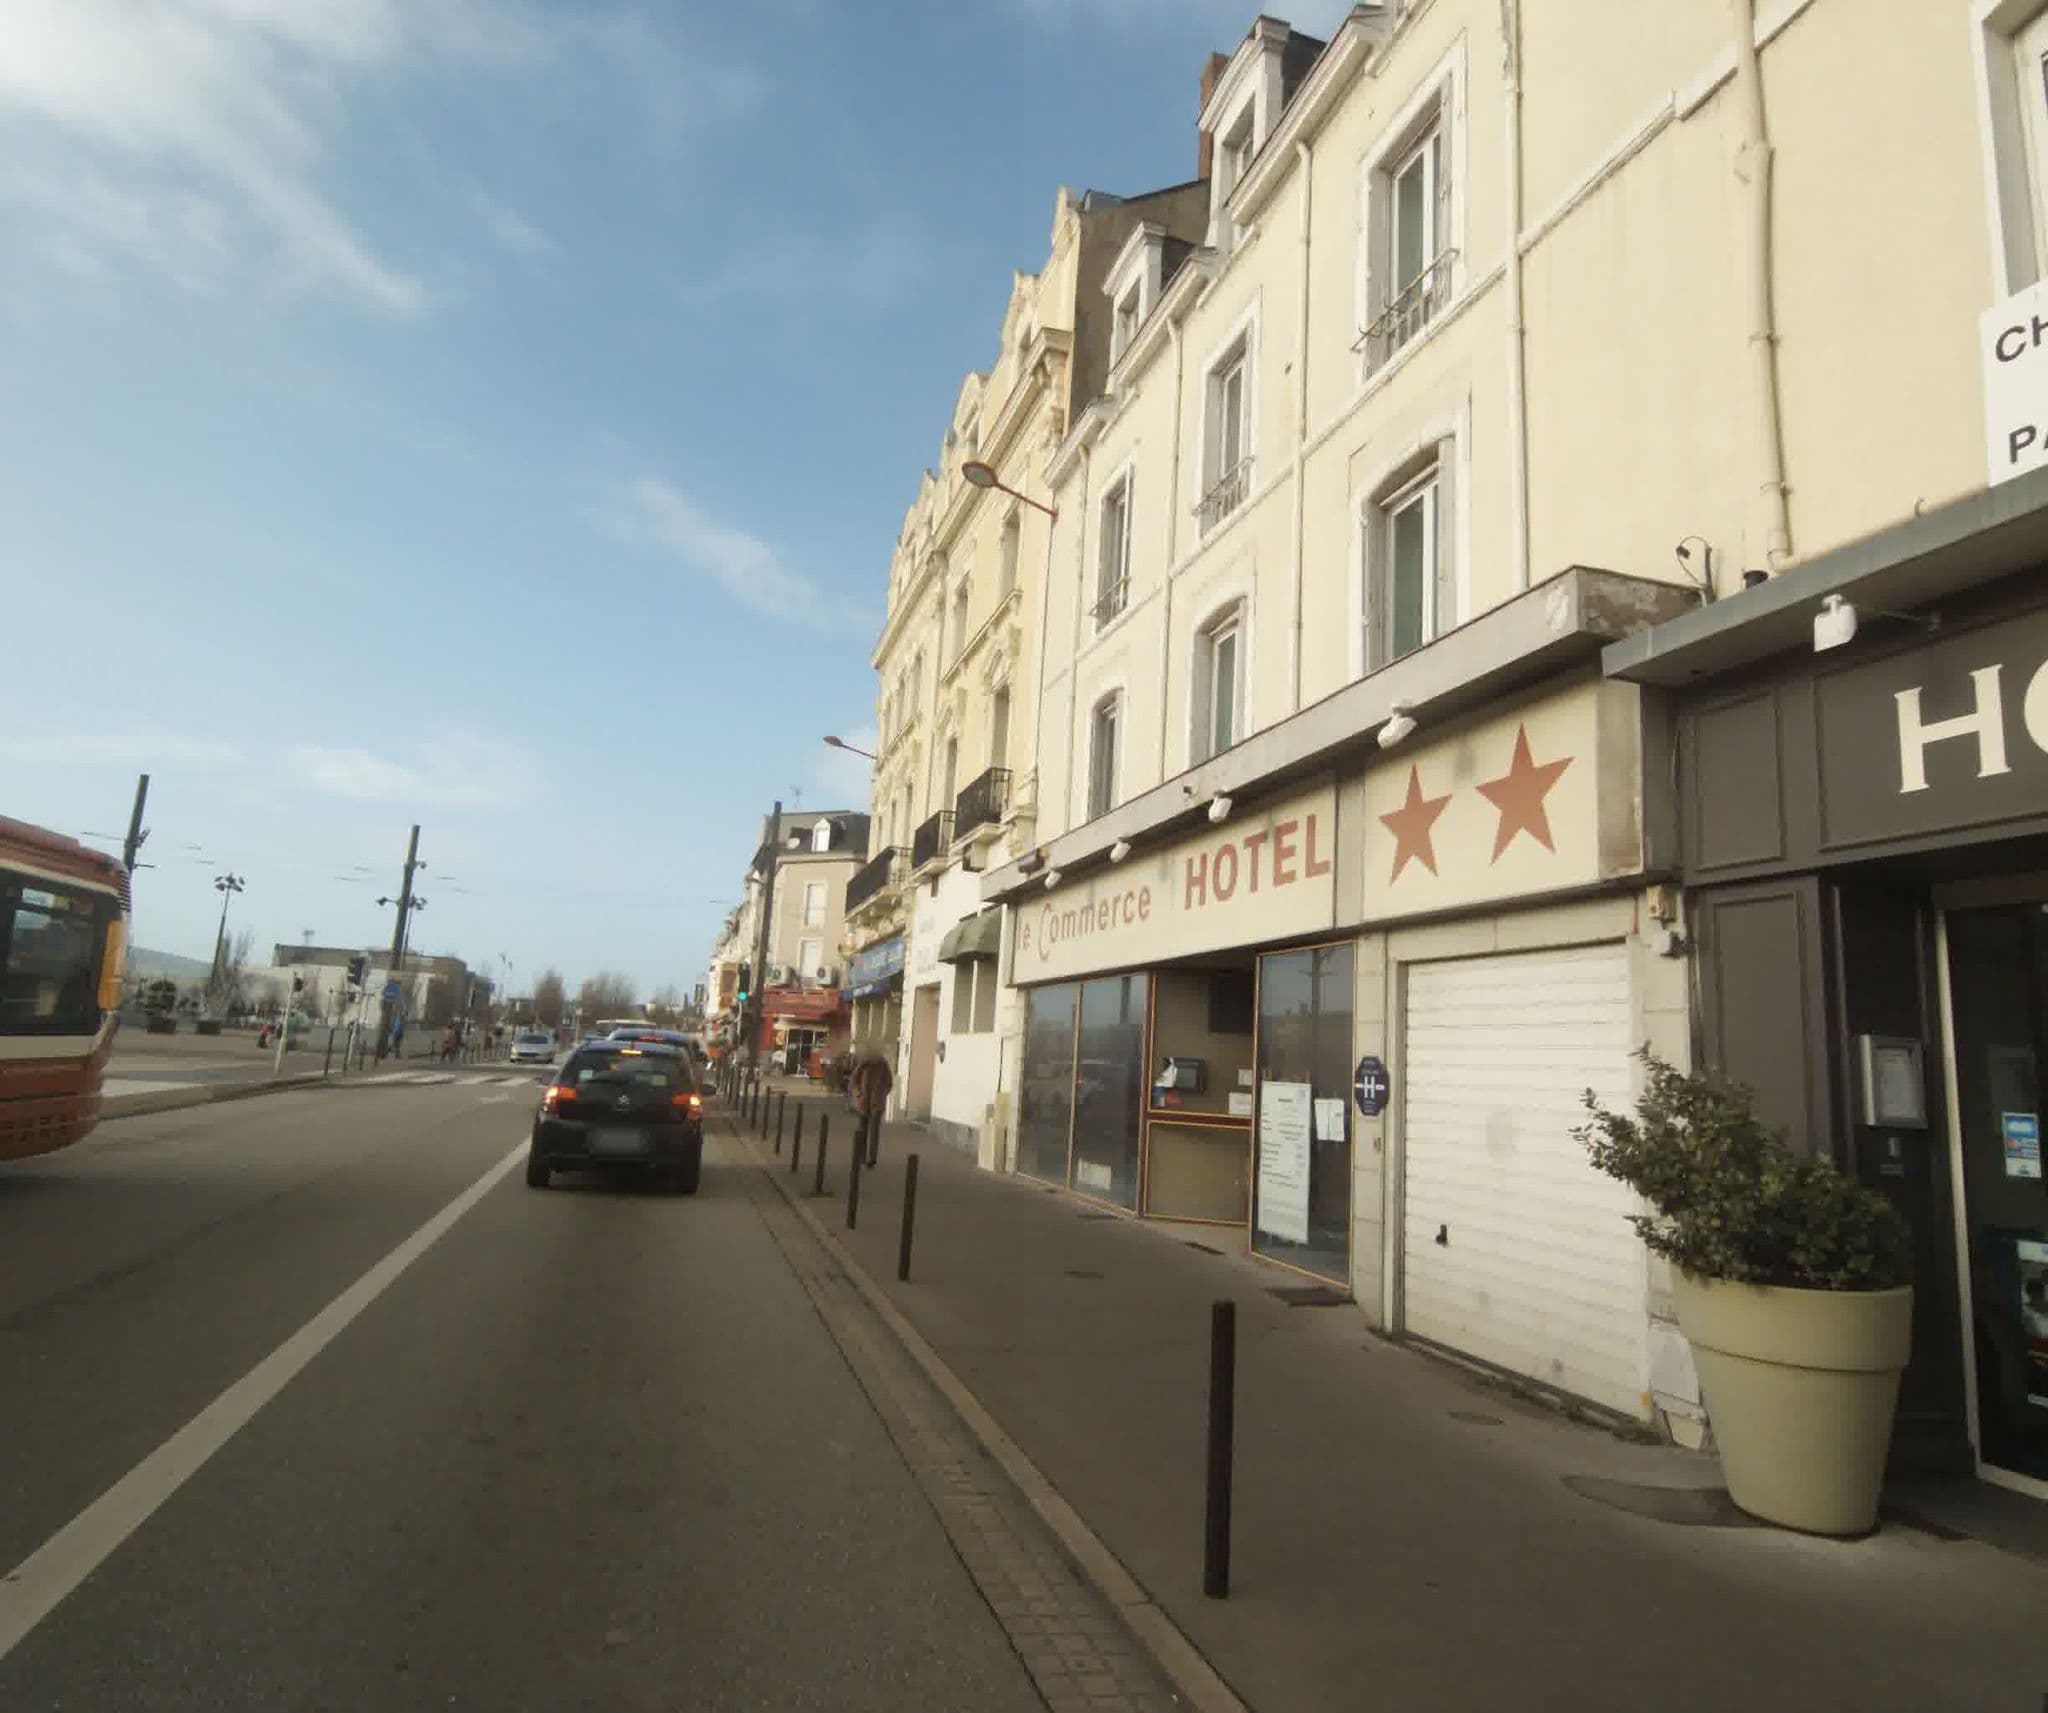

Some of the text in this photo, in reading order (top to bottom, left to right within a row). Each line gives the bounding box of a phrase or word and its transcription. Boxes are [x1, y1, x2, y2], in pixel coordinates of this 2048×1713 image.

[2009, 425, 2048, 463] P
[1894, 658, 2048, 793] H
[1039, 885, 1151, 961] Commerce
[1184, 813, 1331, 911] HOTEL
